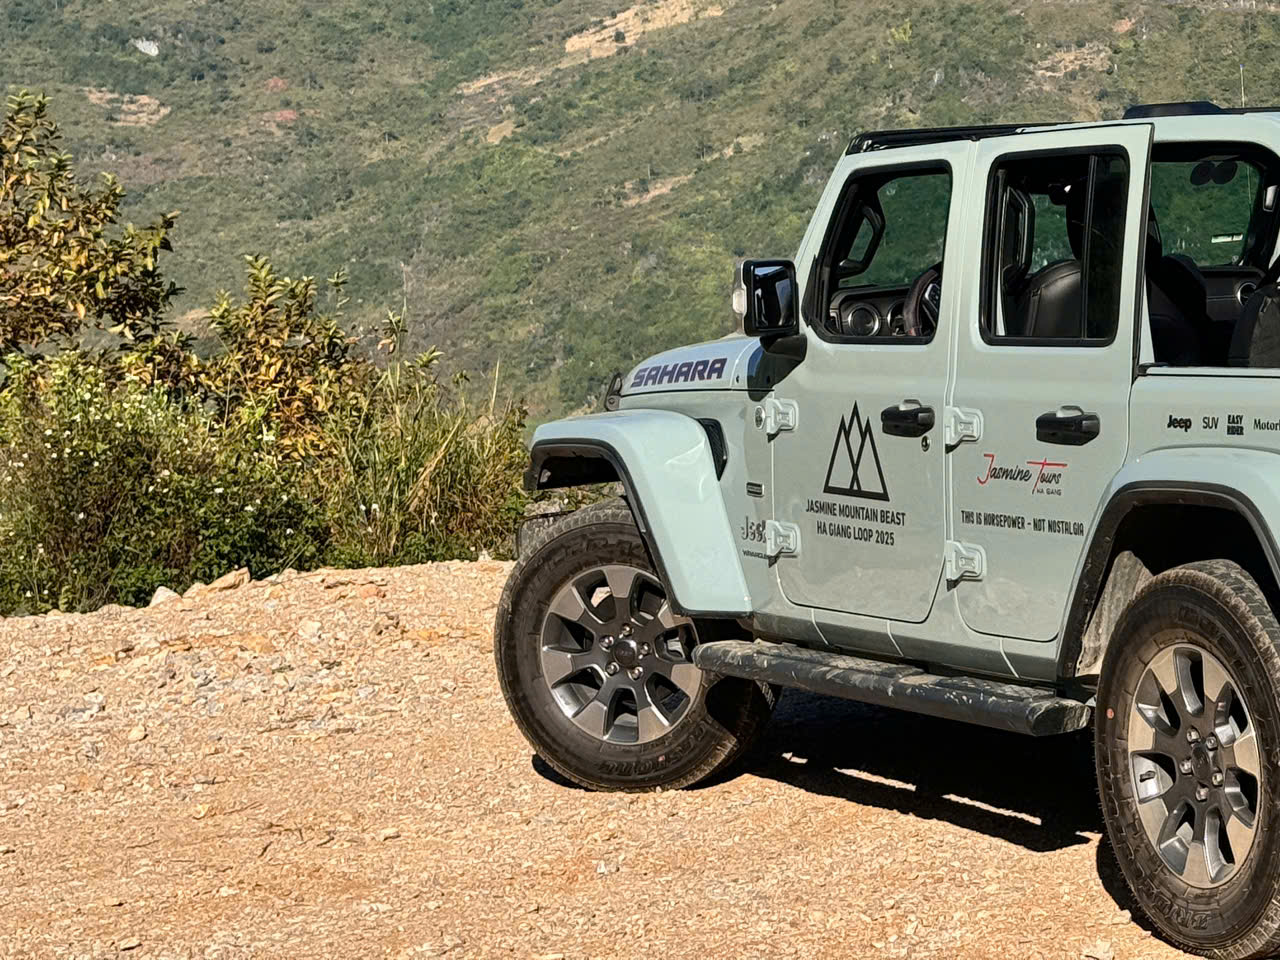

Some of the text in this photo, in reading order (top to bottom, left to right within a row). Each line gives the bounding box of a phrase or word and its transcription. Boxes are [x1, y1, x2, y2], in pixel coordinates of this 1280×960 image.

[630, 357, 728, 388] SAHARA
[1167, 415, 1219, 432] Jeep SUV
[1227, 415, 1244, 425] EASY
[977, 453, 1068, 494] Jasmine Tours
[806, 499, 906, 526] JASMINE MOUNTAIN BEAST
[961, 510, 974, 524] THIS
[976, 512, 982, 525] IS
[983, 513, 1025, 529] HORSEPOWER
[1033, 518, 1046, 532] NOT
[1048, 520, 1084, 536] NOSTALGIA
[816, 520, 895, 546] HA GIANG LOOP 2025
